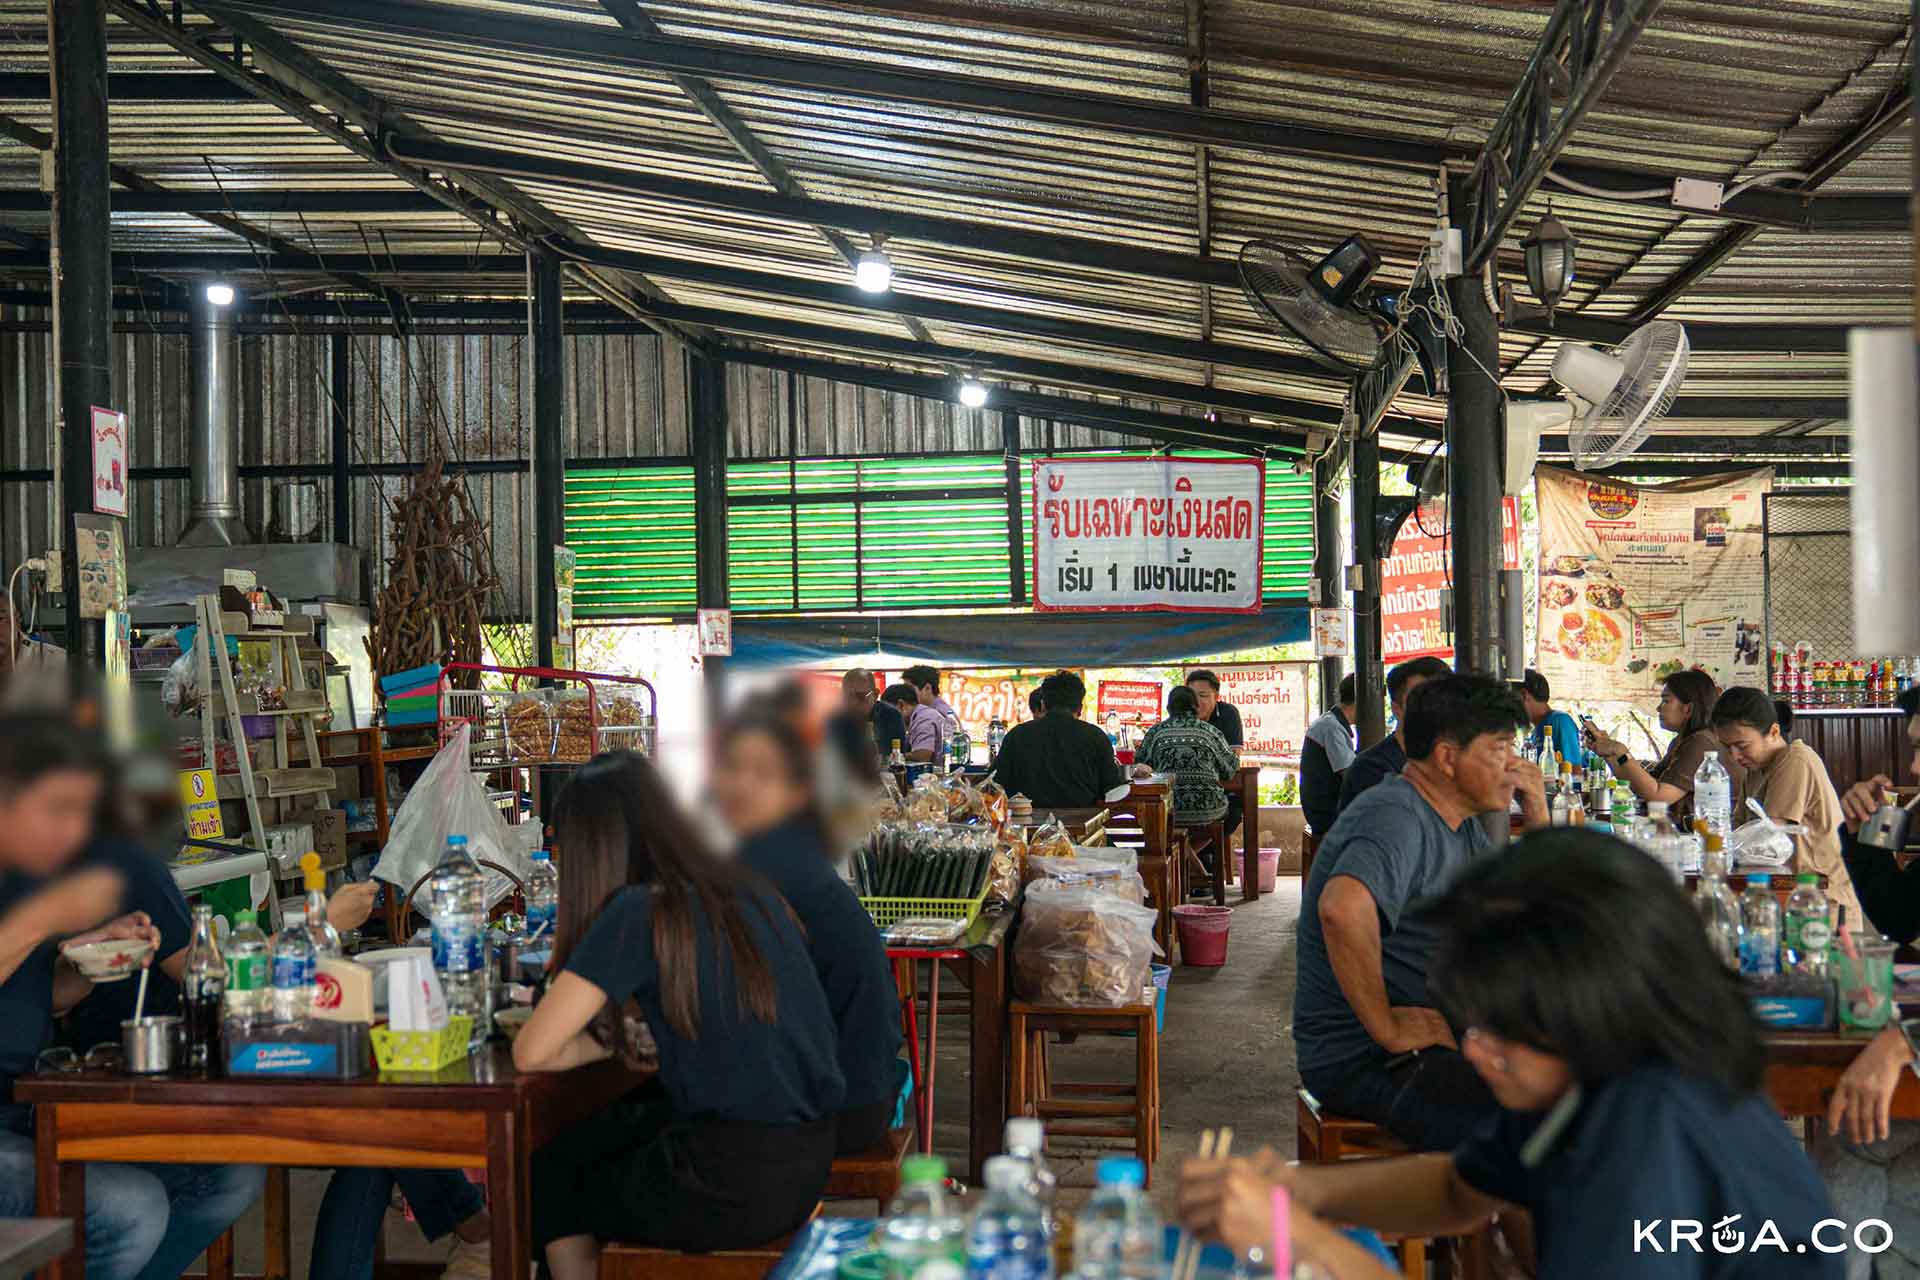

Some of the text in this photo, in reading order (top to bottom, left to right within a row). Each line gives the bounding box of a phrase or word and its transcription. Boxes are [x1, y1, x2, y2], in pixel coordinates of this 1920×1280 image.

[1043, 473, 1252, 540] รับเฉพาะเงินสด
[1058, 548, 1237, 593] เริ่ม 1 เมษานี้นะคะ
[1215, 665, 1284, 688] มนูแนะนำ
[189, 812, 222, 836] ห้ามเข้า
